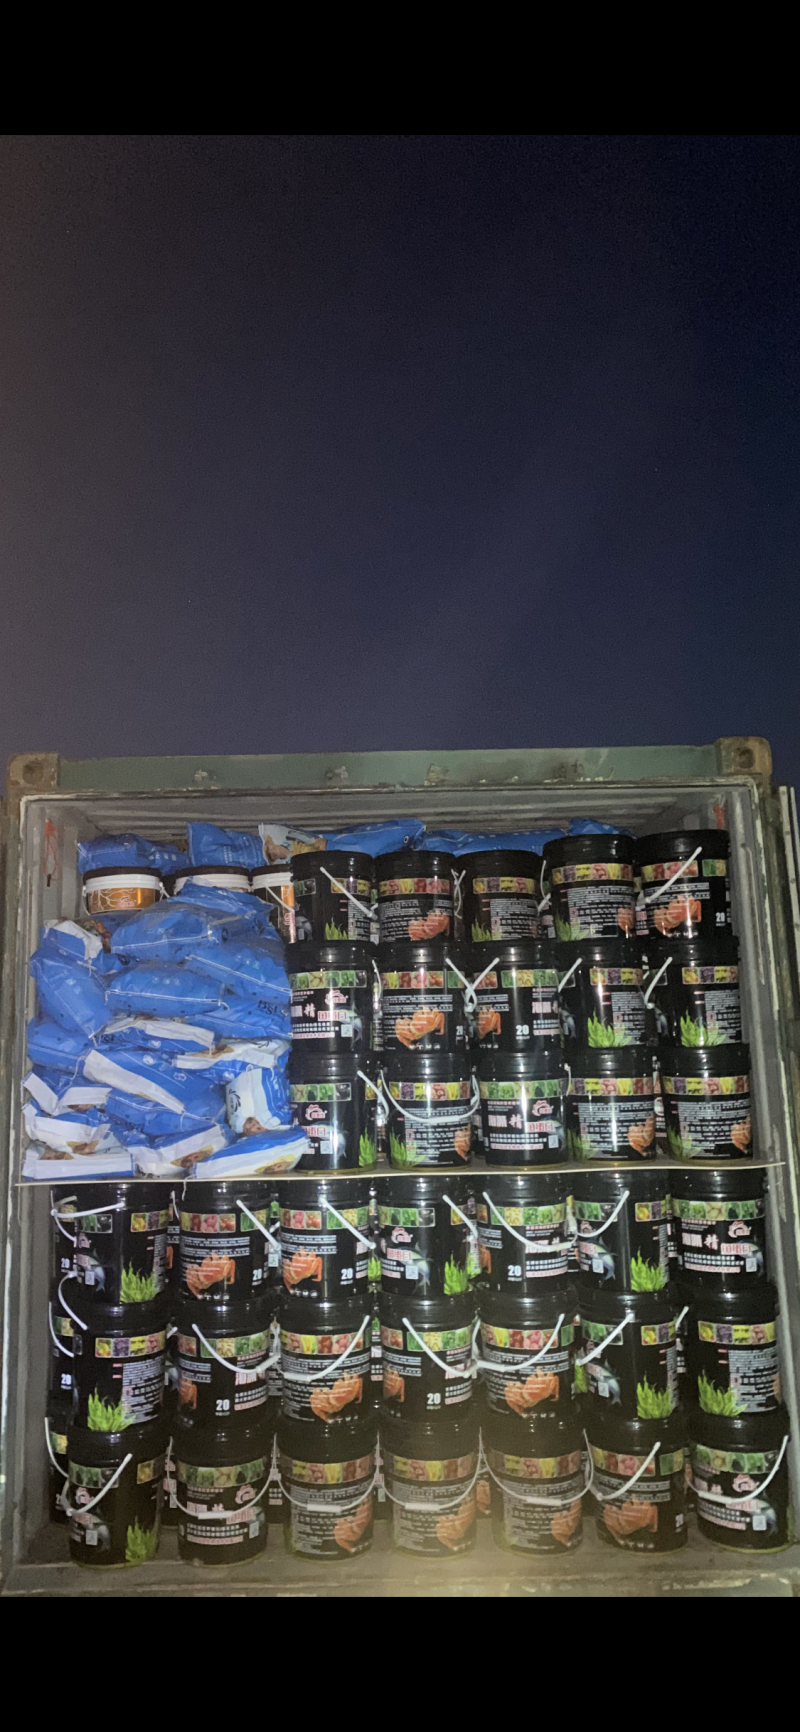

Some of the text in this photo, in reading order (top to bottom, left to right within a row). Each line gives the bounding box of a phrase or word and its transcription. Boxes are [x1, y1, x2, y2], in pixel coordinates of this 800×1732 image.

[716, 912, 726, 922] 20
[516, 1024, 530, 1035] 20
[252, 1268, 263, 1281] 20
[341, 1267, 354, 1280] 20
[507, 1264, 522, 1277] 20
[61, 1373, 72, 1385] 20
[427, 1392, 442, 1404] 20
[215, 1399, 231, 1411] 20
